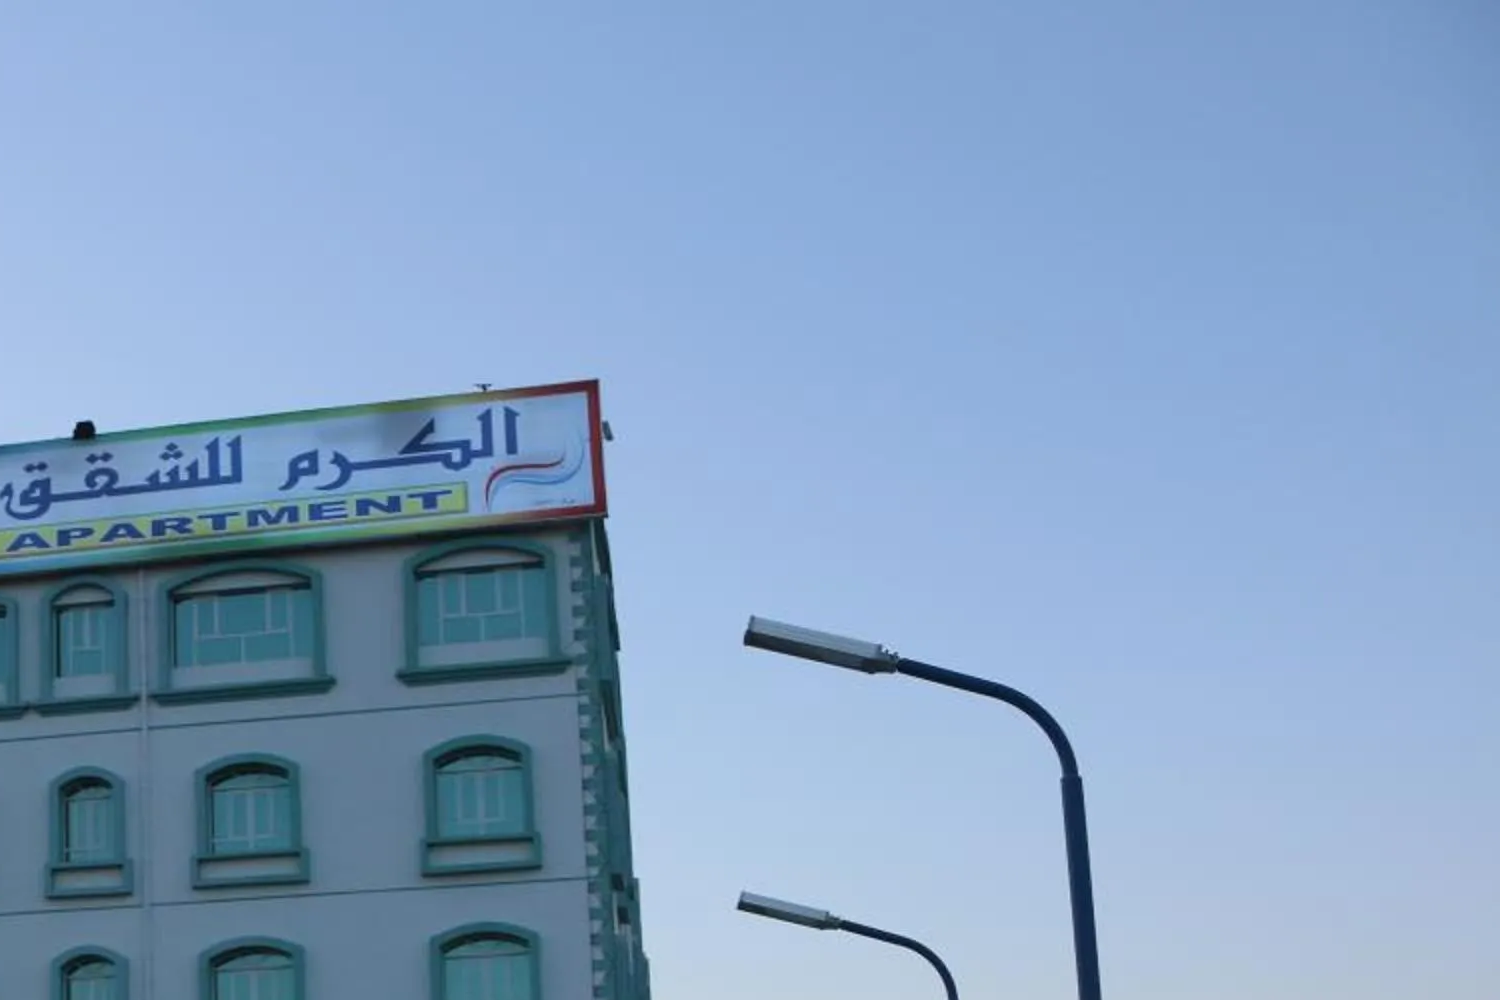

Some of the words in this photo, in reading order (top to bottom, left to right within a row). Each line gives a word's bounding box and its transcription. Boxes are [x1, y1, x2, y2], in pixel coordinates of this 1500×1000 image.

[0, 434, 243, 520] للشقق
[280, 406, 521, 490] الكرم
[6, 489, 453, 552] APARTMENT
